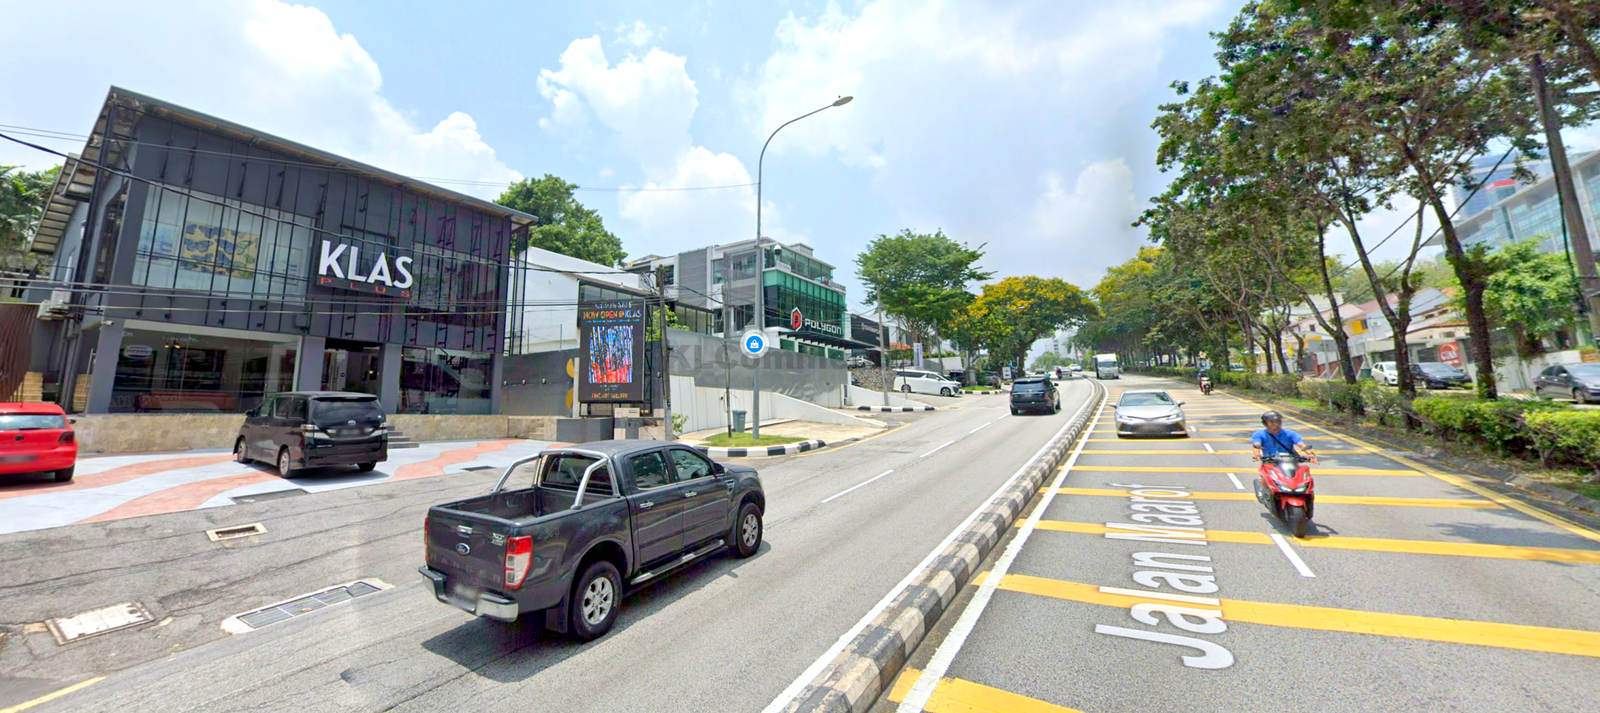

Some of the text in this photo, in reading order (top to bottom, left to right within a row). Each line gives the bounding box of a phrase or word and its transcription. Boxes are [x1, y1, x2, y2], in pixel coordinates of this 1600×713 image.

[319, 240, 413, 289] KLAS
[320, 277, 410, 297] PLUS
[583, 311, 600, 319] NOW
[600, 310, 618, 319] OPEN
[804, 318, 842, 335] POLYGON
[430, 554, 501, 583] RANGER
